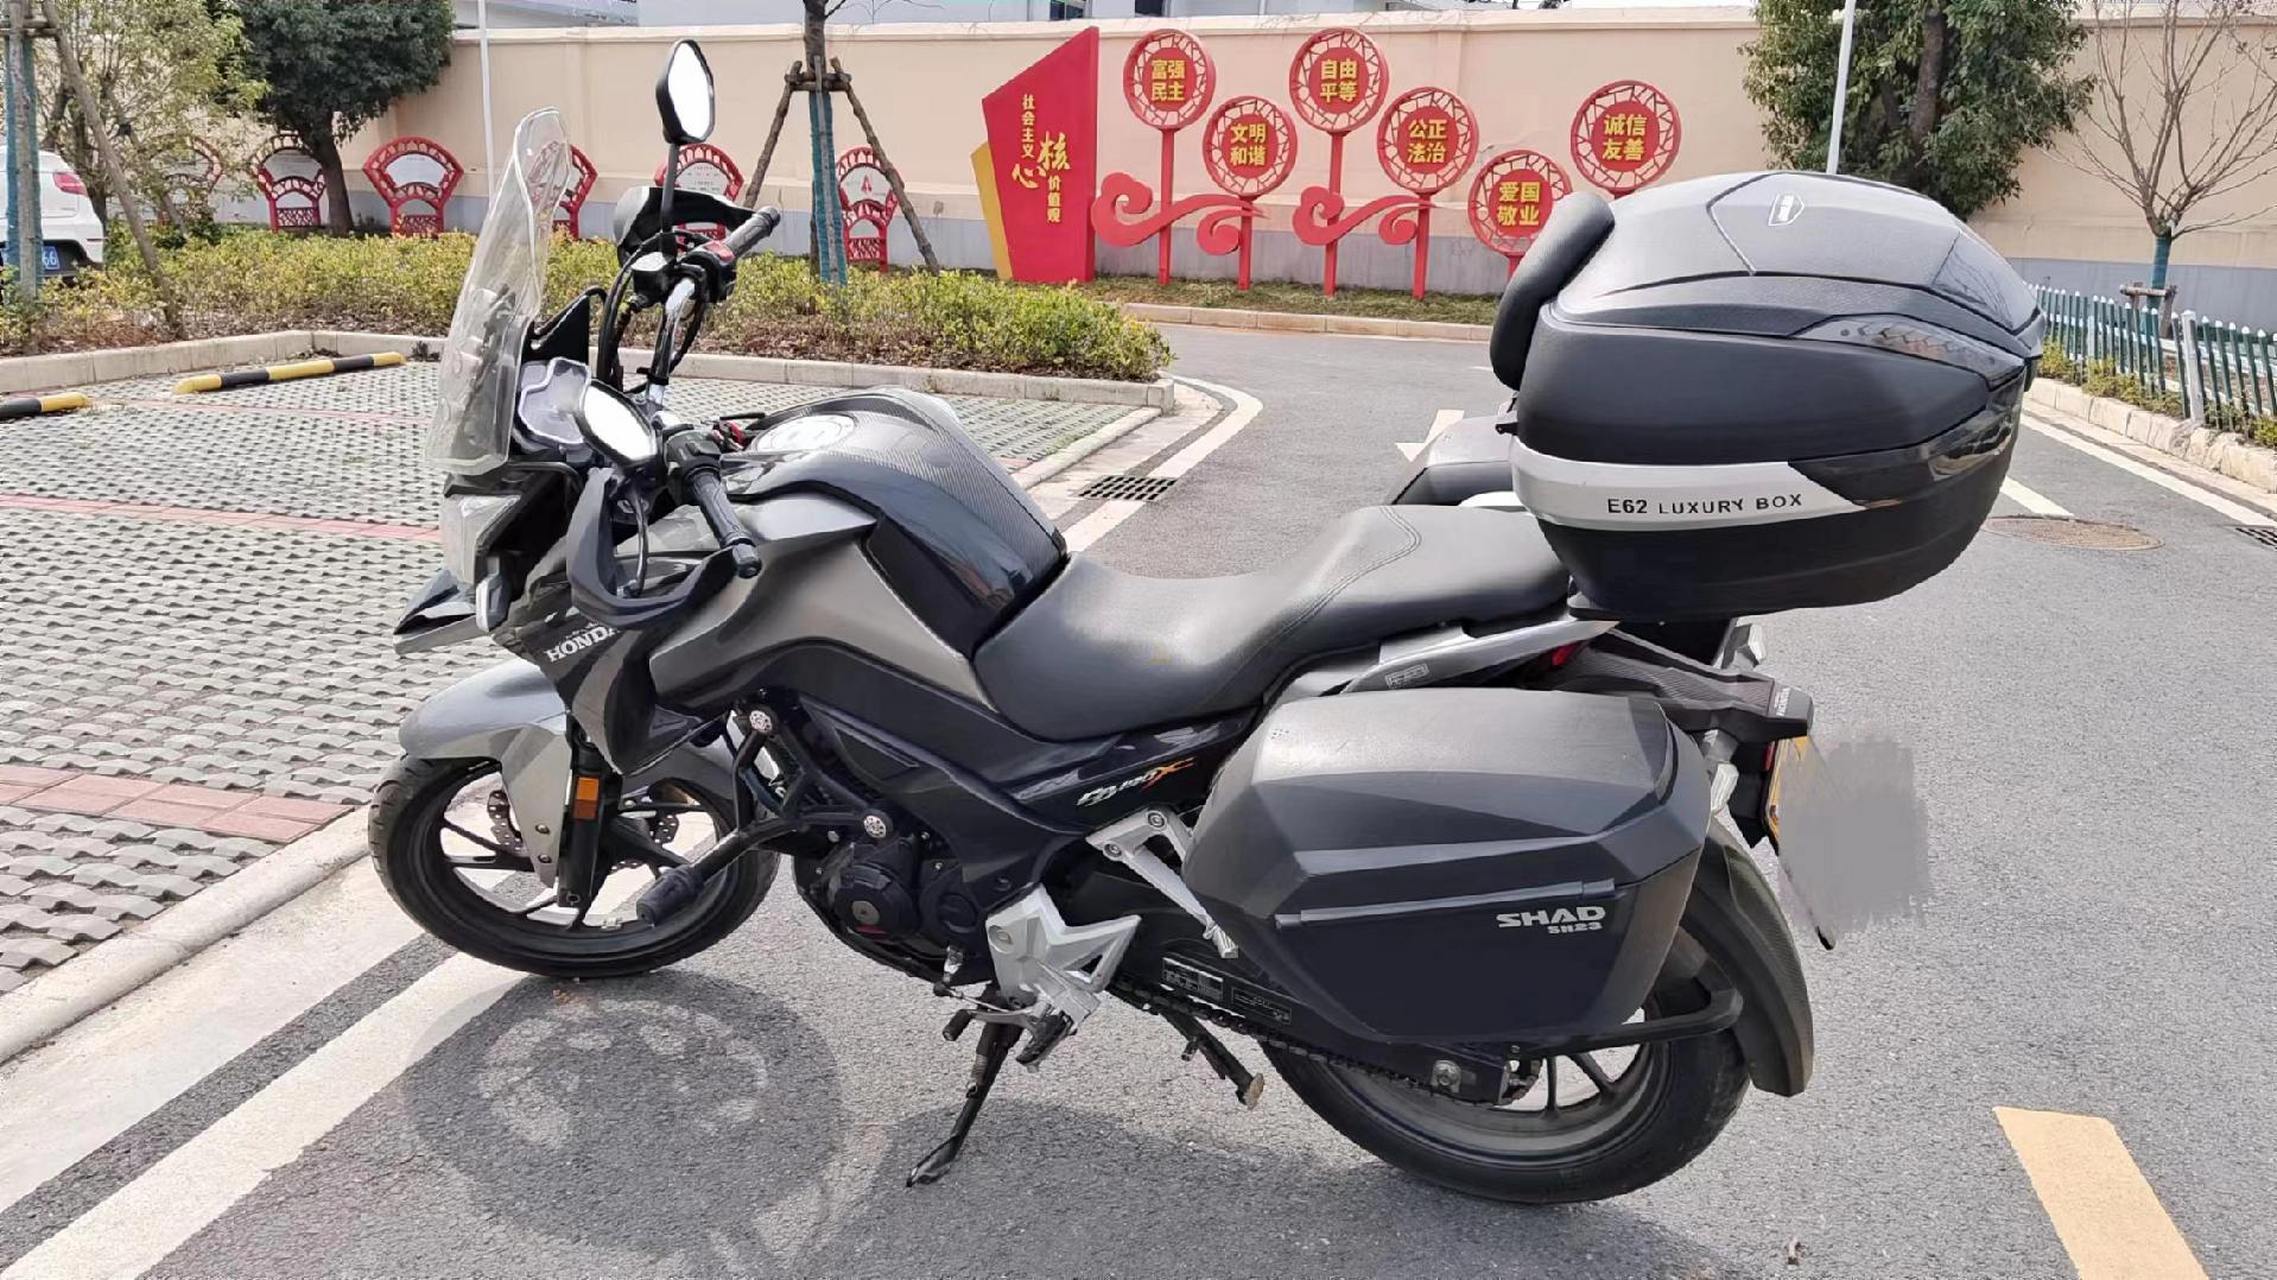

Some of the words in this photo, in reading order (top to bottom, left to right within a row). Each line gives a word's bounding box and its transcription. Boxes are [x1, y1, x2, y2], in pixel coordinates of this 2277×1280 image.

[1151, 60, 1185, 80] 富强
[1320, 59, 1357, 79] 自由
[1151, 81, 1185, 101] 民主
[1319, 81, 1357, 102] 平等
[1021, 93, 1036, 158] 社会主义
[1230, 123, 1266, 143] 文明
[1408, 119, 1447, 140] 公正
[1603, 114, 1648, 136] 诚信
[1229, 146, 1266, 166] 和谐
[1408, 143, 1446, 163] 法治
[1602, 139, 1646, 161] 友善
[1047, 174, 1061, 223] 价值观
[1498, 182, 1541, 203] 爱国
[1497, 205, 1540, 227] 敬业
[1607, 498, 1648, 514] E62
[1658, 498, 1744, 514] LUXURY
[1755, 493, 1802, 510] BOX
[1496, 906, 1606, 928] SHAD
